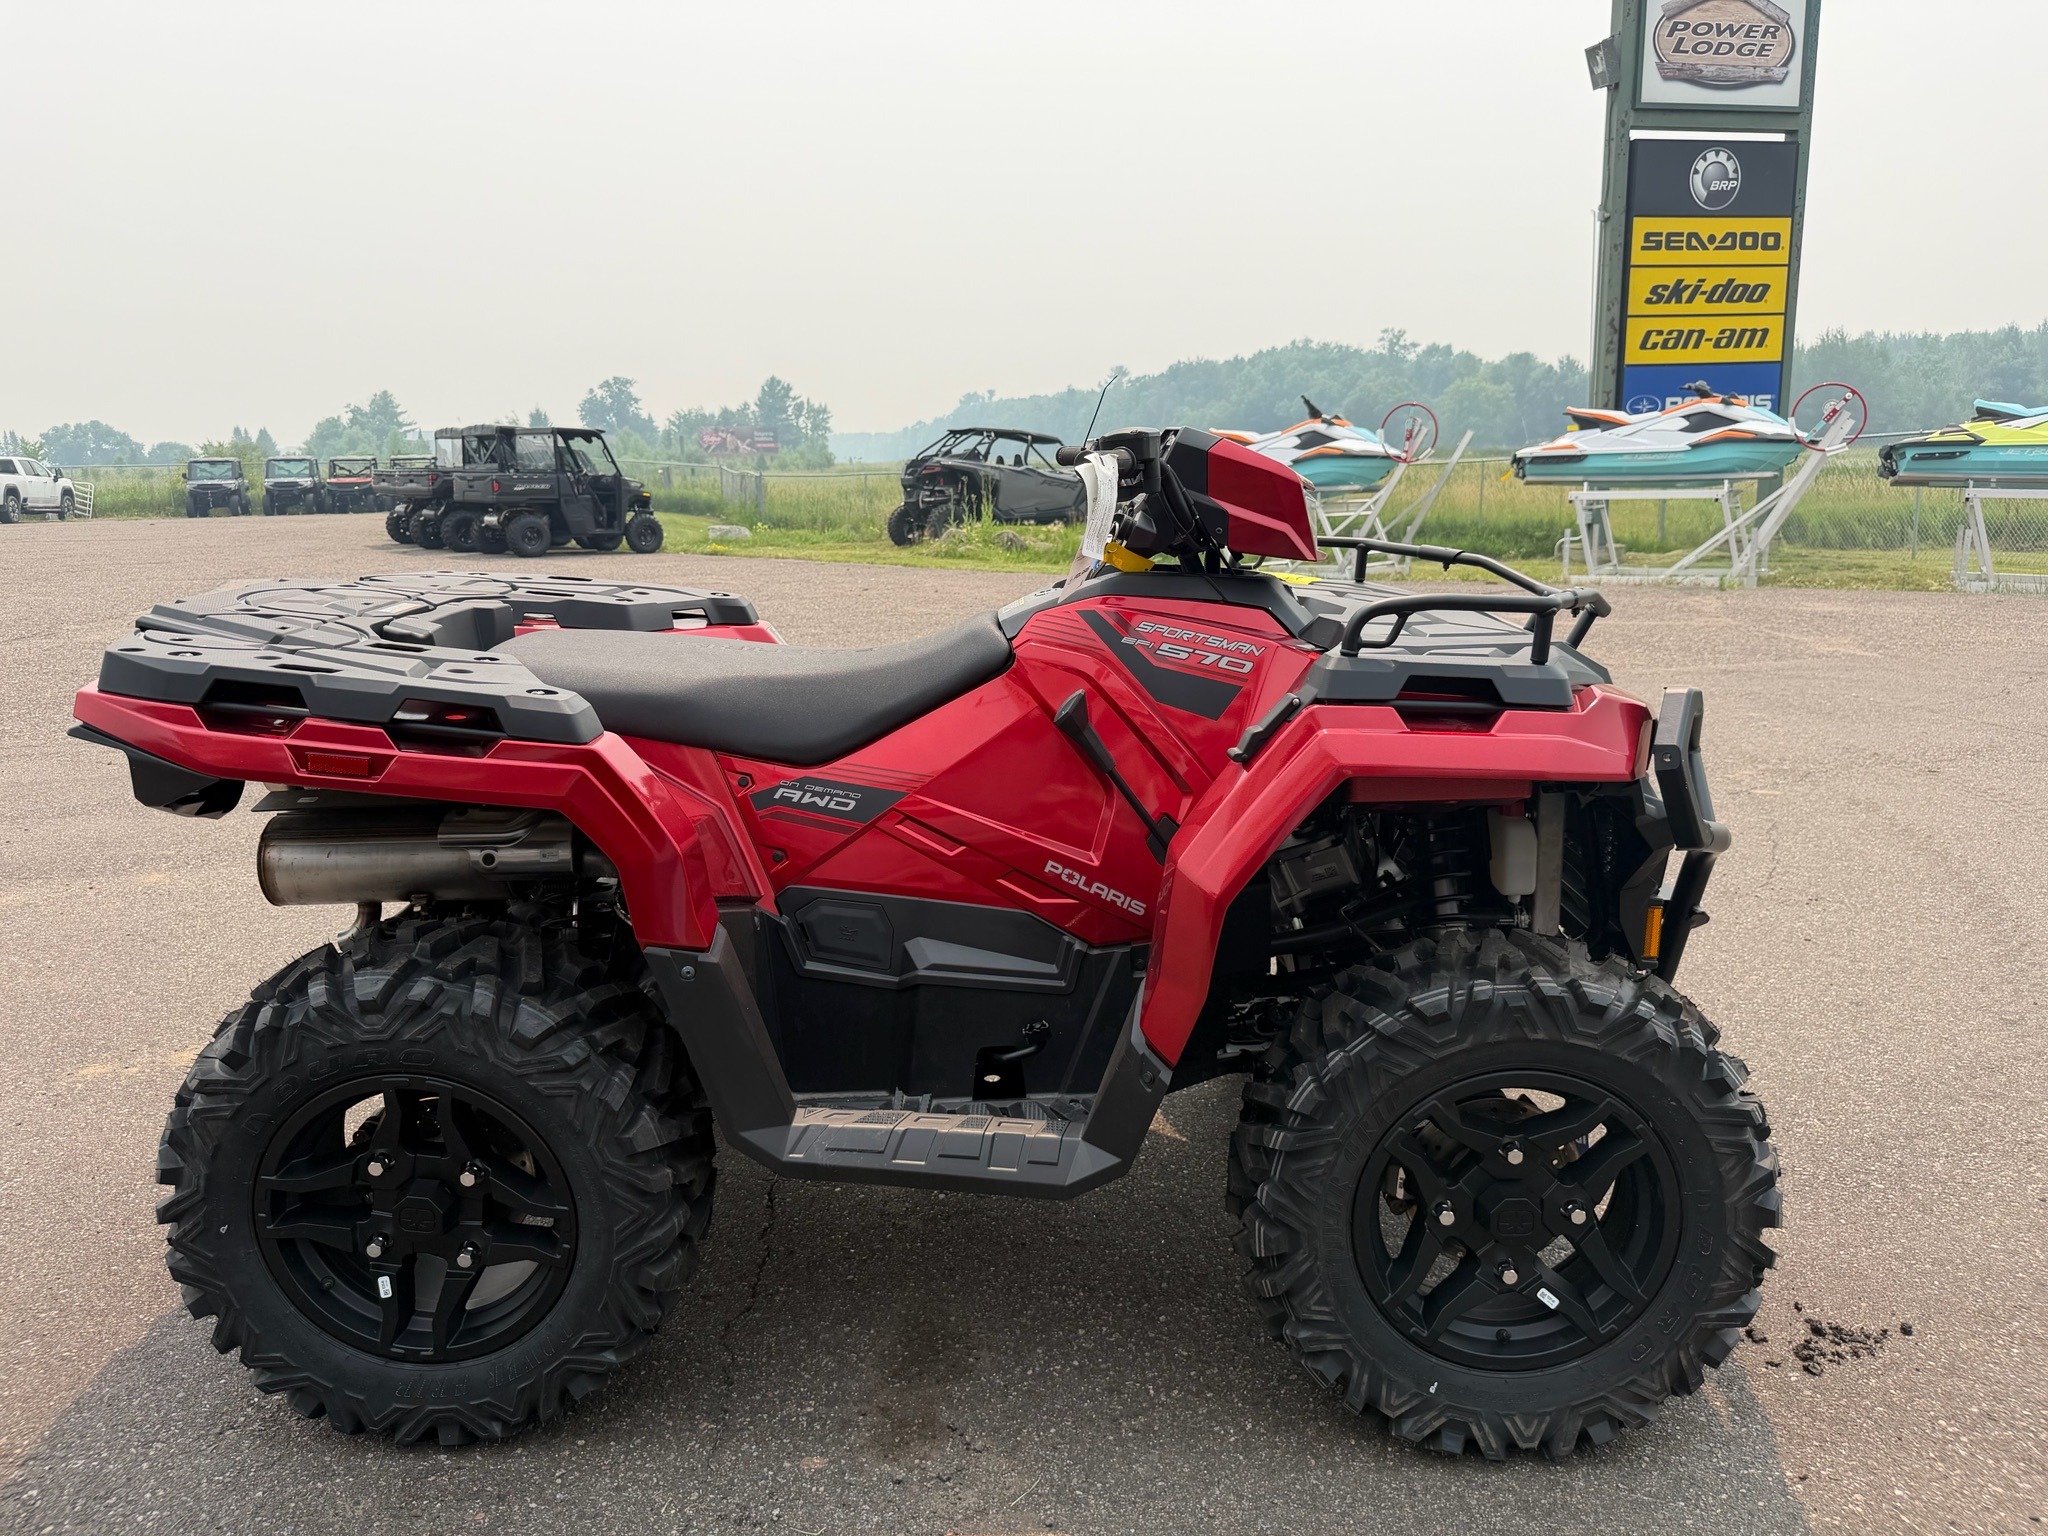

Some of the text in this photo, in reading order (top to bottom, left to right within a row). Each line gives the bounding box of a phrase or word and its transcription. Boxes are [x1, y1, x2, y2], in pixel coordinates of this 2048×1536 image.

[1665, 20, 1782, 40] POWER
[1670, 36, 1776, 58] LODGE
[1709, 180, 1738, 191] BRP
[1643, 278, 1772, 305] ski-doo
[1638, 327, 1770, 351] can-am
[1040, 479, 1078, 491] RZR
[1134, 621, 1266, 657] SPORTSMAN
[1120, 636, 1255, 675] EFI 570
[773, 787, 857, 812] AWD
[779, 779, 862, 800] ON DEMAND
[1044, 860, 1147, 916] POLARIS
